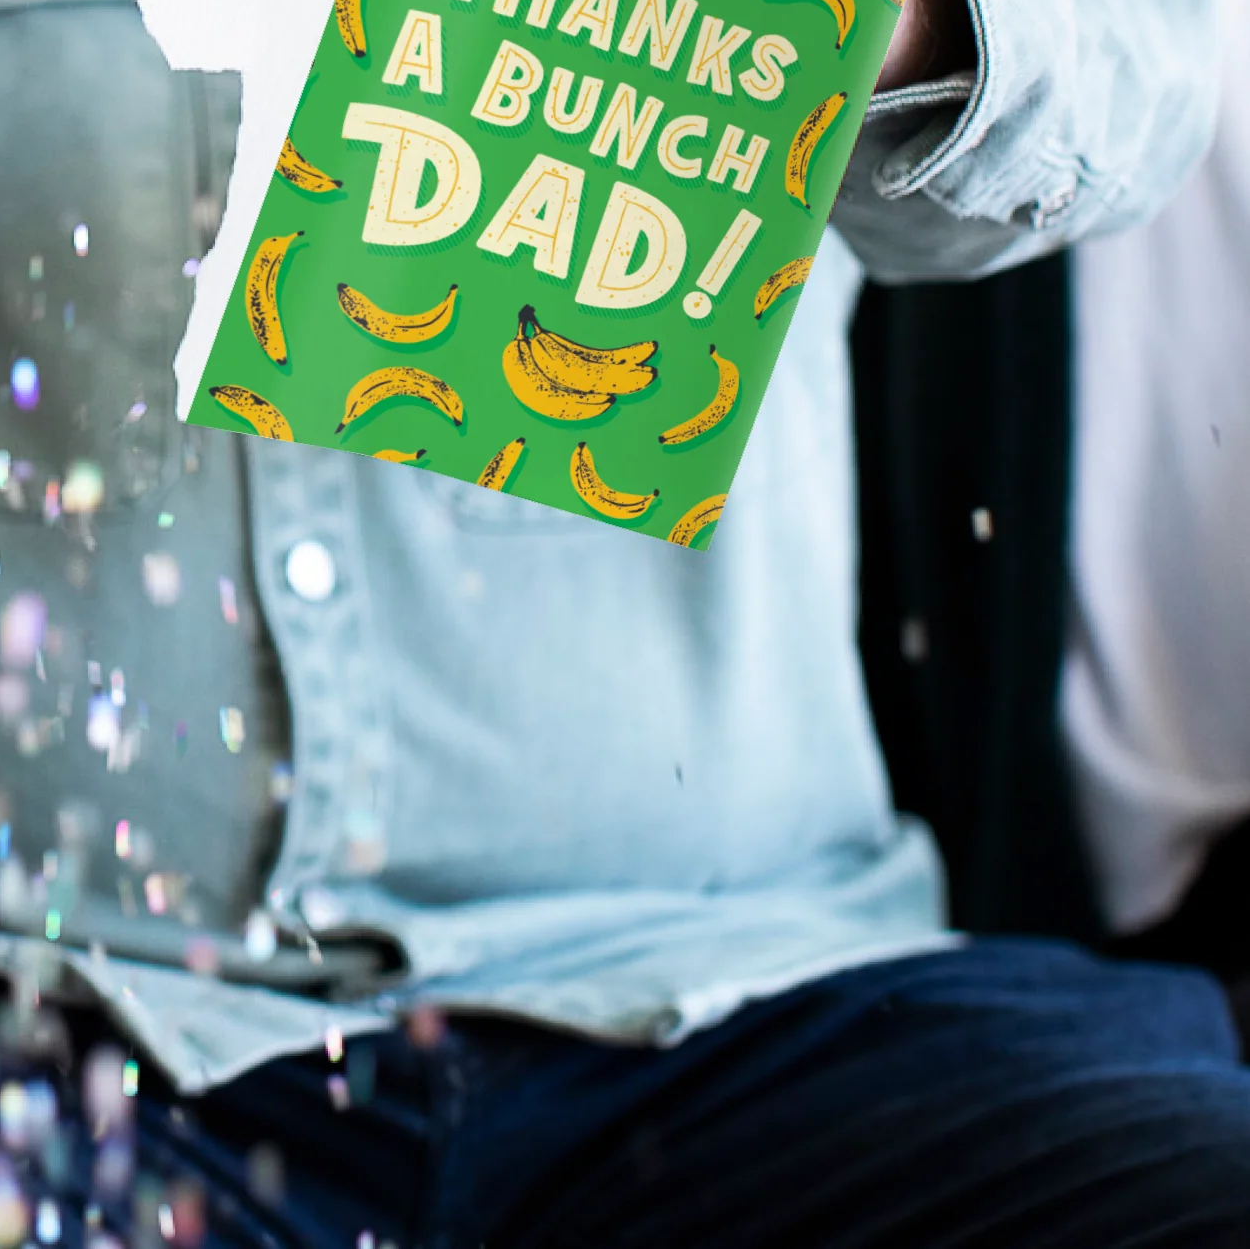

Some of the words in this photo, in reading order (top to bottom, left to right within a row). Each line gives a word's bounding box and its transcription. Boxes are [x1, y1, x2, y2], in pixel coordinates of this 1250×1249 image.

[381, 9, 442, 95] A
[470, 40, 770, 193] BUNCH
[341, 102, 762, 320] DAD!
